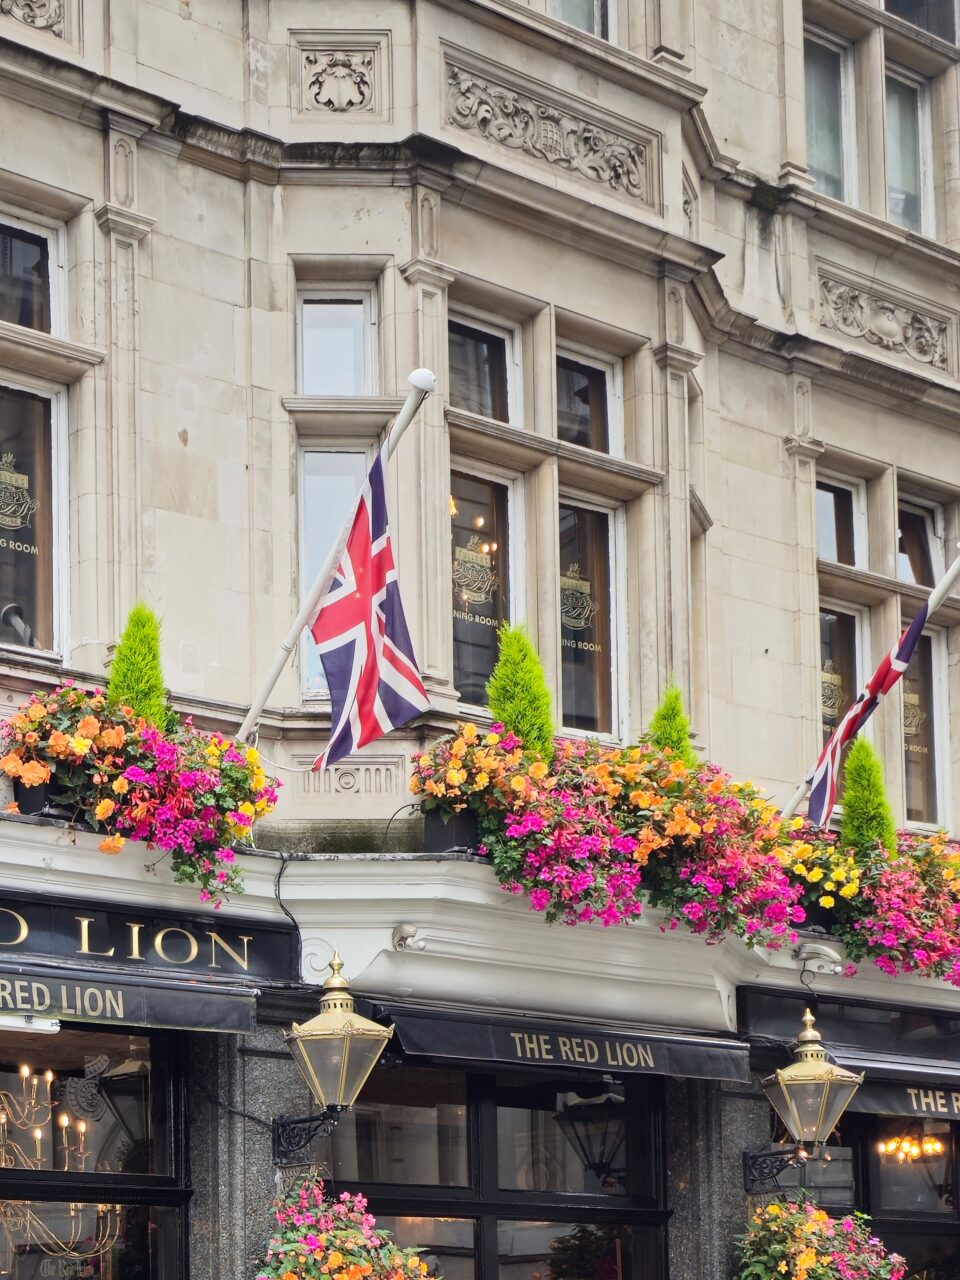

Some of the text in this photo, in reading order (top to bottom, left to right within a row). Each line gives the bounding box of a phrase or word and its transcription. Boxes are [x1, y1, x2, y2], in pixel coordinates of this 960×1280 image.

[9, 540, 40, 555] ROOM
[453, 609, 499, 627] NING ROOM
[577, 641, 602, 652] ROOM
[75, 916, 253, 972] LION
[61, 985, 125, 1019] LION
[510, 1032, 655, 1068] THE RED LION
[907, 1088, 948, 1113] THE
